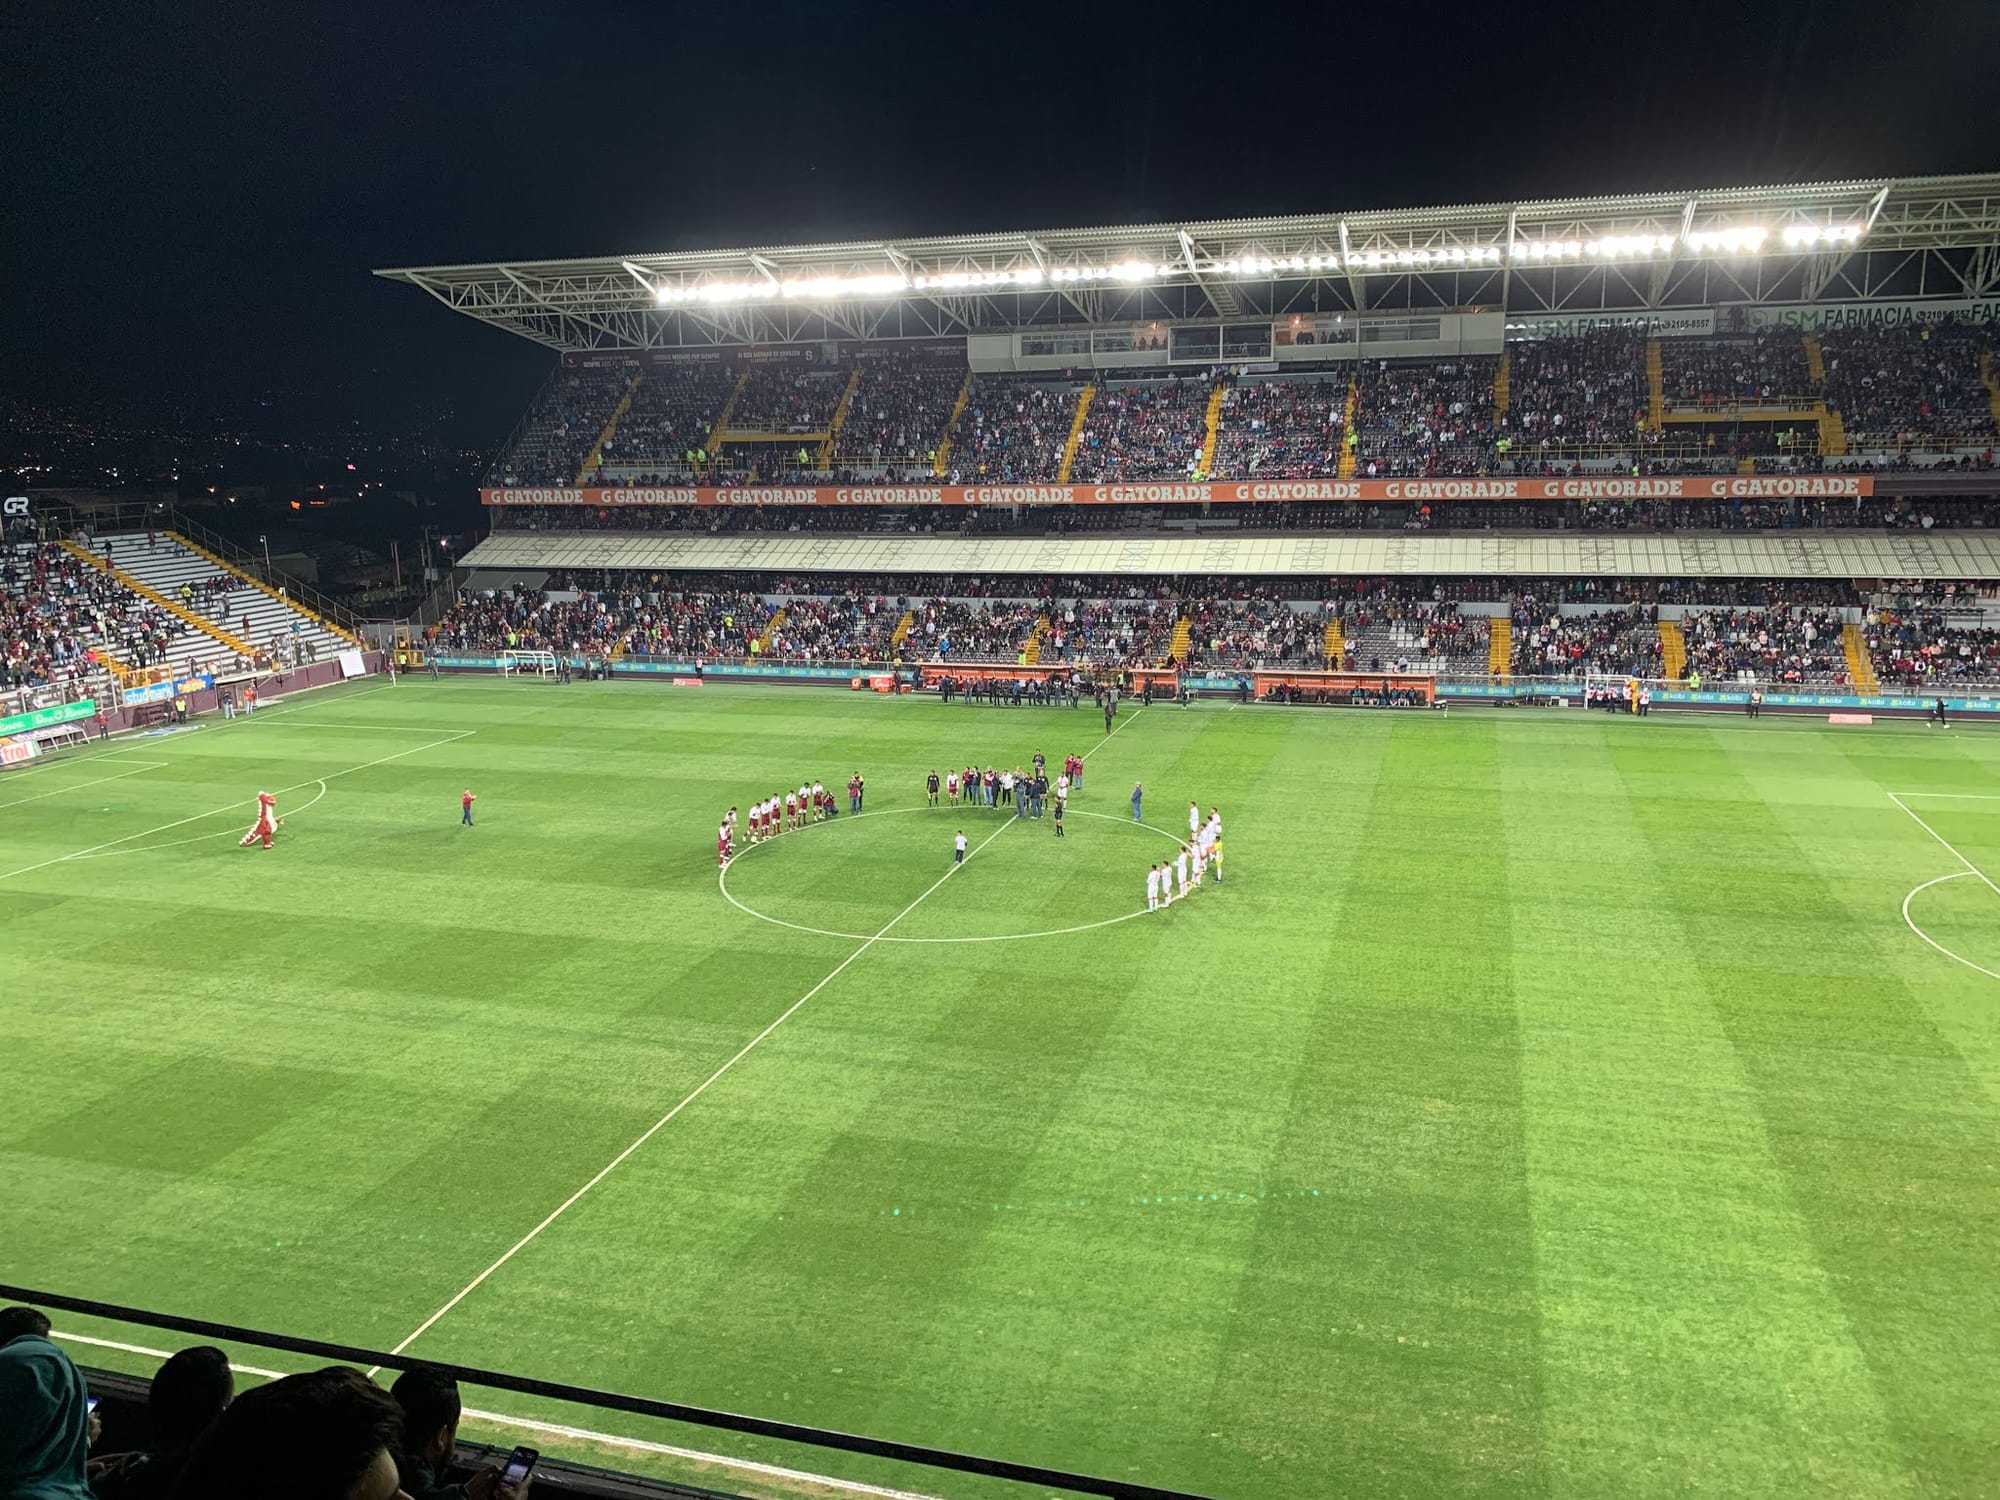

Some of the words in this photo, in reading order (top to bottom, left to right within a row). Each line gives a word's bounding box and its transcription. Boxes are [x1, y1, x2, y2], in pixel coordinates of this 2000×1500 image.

[1824, 307, 1913, 328] FARMACIA
[1111, 486, 1212, 501] GATORADE
[1253, 484, 1361, 499] GATORADE
[1404, 482, 1518, 498] GATORADE
[1563, 480, 1683, 497] GATORADE
[1731, 478, 1859, 495] GATORADE
[503, 490, 584, 503] GATORADE
[614, 490, 698, 503] GATORADE
[730, 490, 817, 503] GATORADE
[851, 489, 942, 503] GATORADE
[978, 488, 1073, 502] GATORADE
[4, 497, 29, 514] GR
